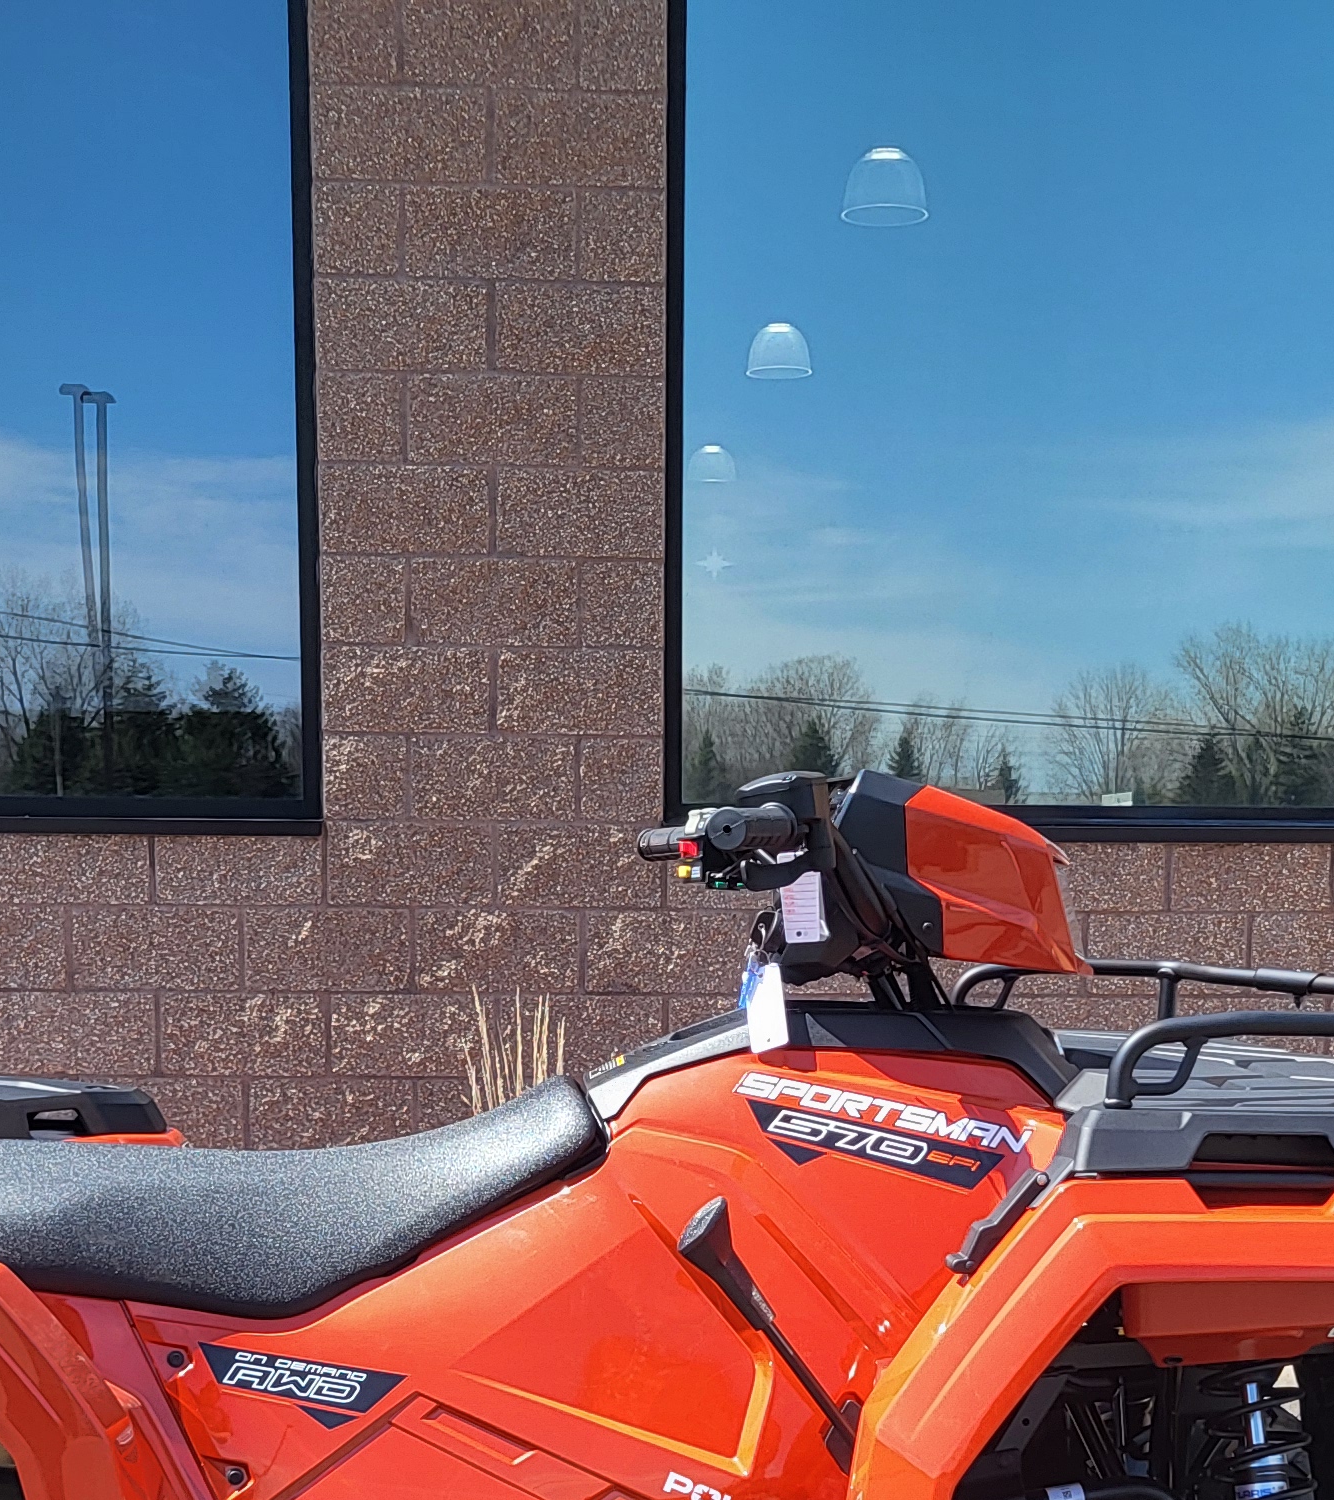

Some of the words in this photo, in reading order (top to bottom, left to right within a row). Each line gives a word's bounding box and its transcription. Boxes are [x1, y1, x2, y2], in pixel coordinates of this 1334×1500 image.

[732, 1071, 1033, 1152] SPORTSMAN
[767, 1110, 928, 1164] 570
[925, 1151, 981, 1172] EFI
[222, 1362, 361, 1404] AWD
[235, 1351, 267, 1364] ON
[274, 1358, 367, 1382] DEMAND
